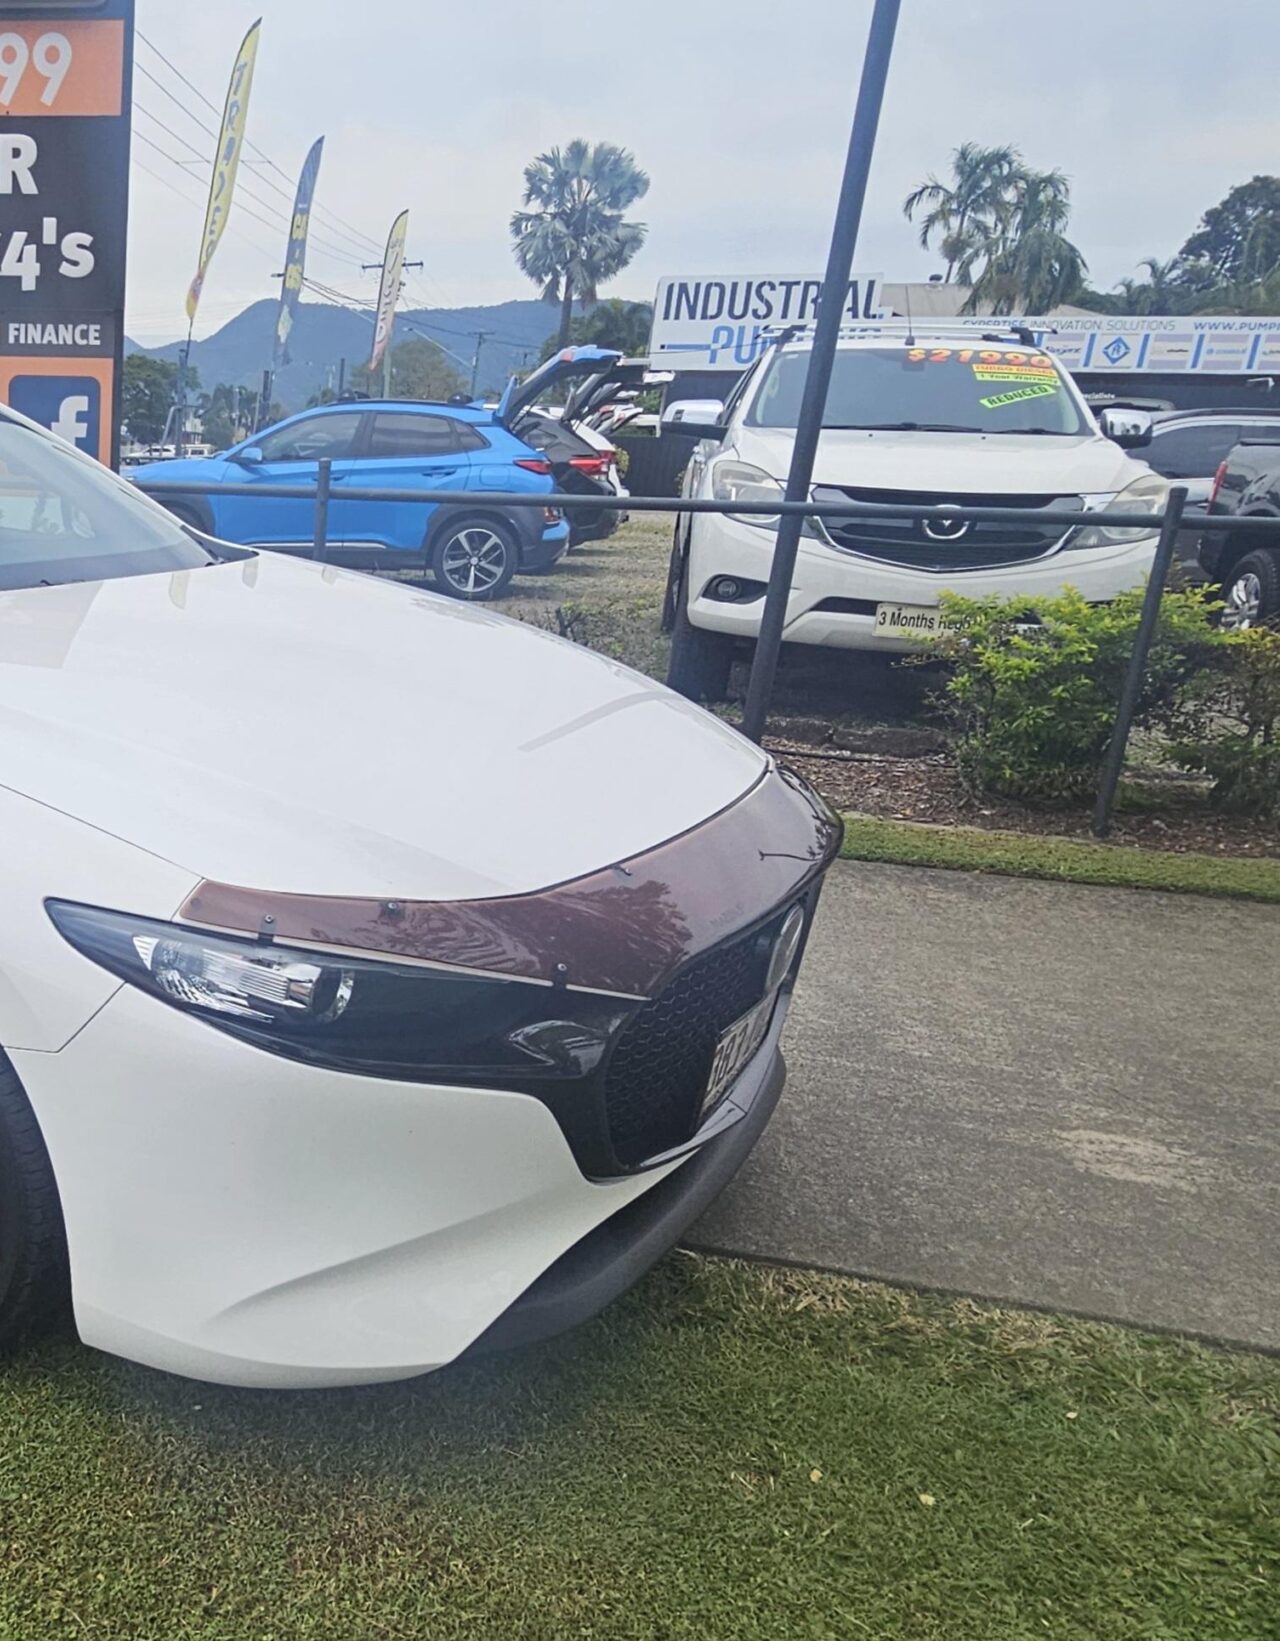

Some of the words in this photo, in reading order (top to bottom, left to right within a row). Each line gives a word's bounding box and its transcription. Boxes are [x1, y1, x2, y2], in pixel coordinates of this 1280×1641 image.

[8, 323, 102, 346] FINANCE
[1030, 319, 1102, 331] INNOVATION
[1106, 319, 1176, 331] SOLUTIONS
[907, 348, 1053, 368] $21990
[987, 386, 1050, 406] REDUCED
[878, 611, 887, 626] 3
[889, 611, 935, 630] Months
